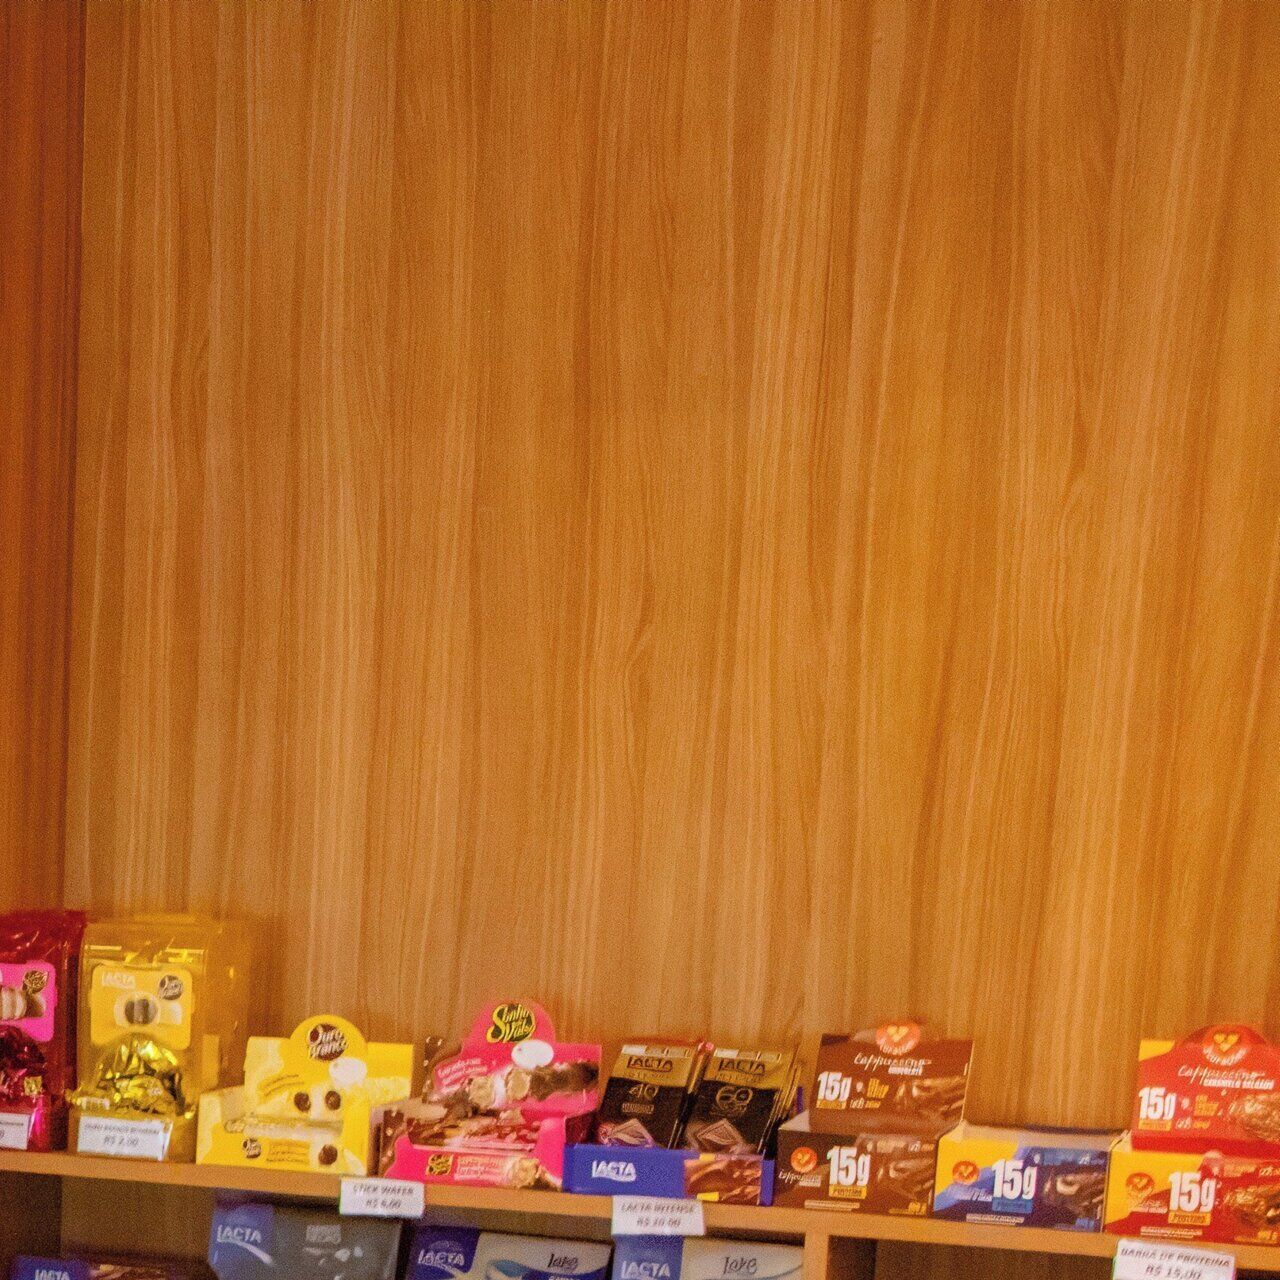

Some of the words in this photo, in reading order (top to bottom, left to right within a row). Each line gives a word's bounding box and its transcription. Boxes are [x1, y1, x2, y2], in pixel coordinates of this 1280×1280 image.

[817, 1071, 852, 1102] 15g
[1139, 1086, 1177, 1121] 15g
[592, 1160, 637, 1182] LACTA
[827, 1145, 871, 1187] 15g
[991, 1158, 1038, 1201] 15g
[1168, 1171, 1217, 1214] 15g
[217, 1224, 263, 1243] LACTA
[418, 1249, 465, 1267] LACTA
[1121, 1247, 1157, 1260] BARRA
[1160, 1251, 1175, 1260] DE
[622, 1260, 672, 1279] LACTA
[1145, 1264, 1162, 1277] R$
